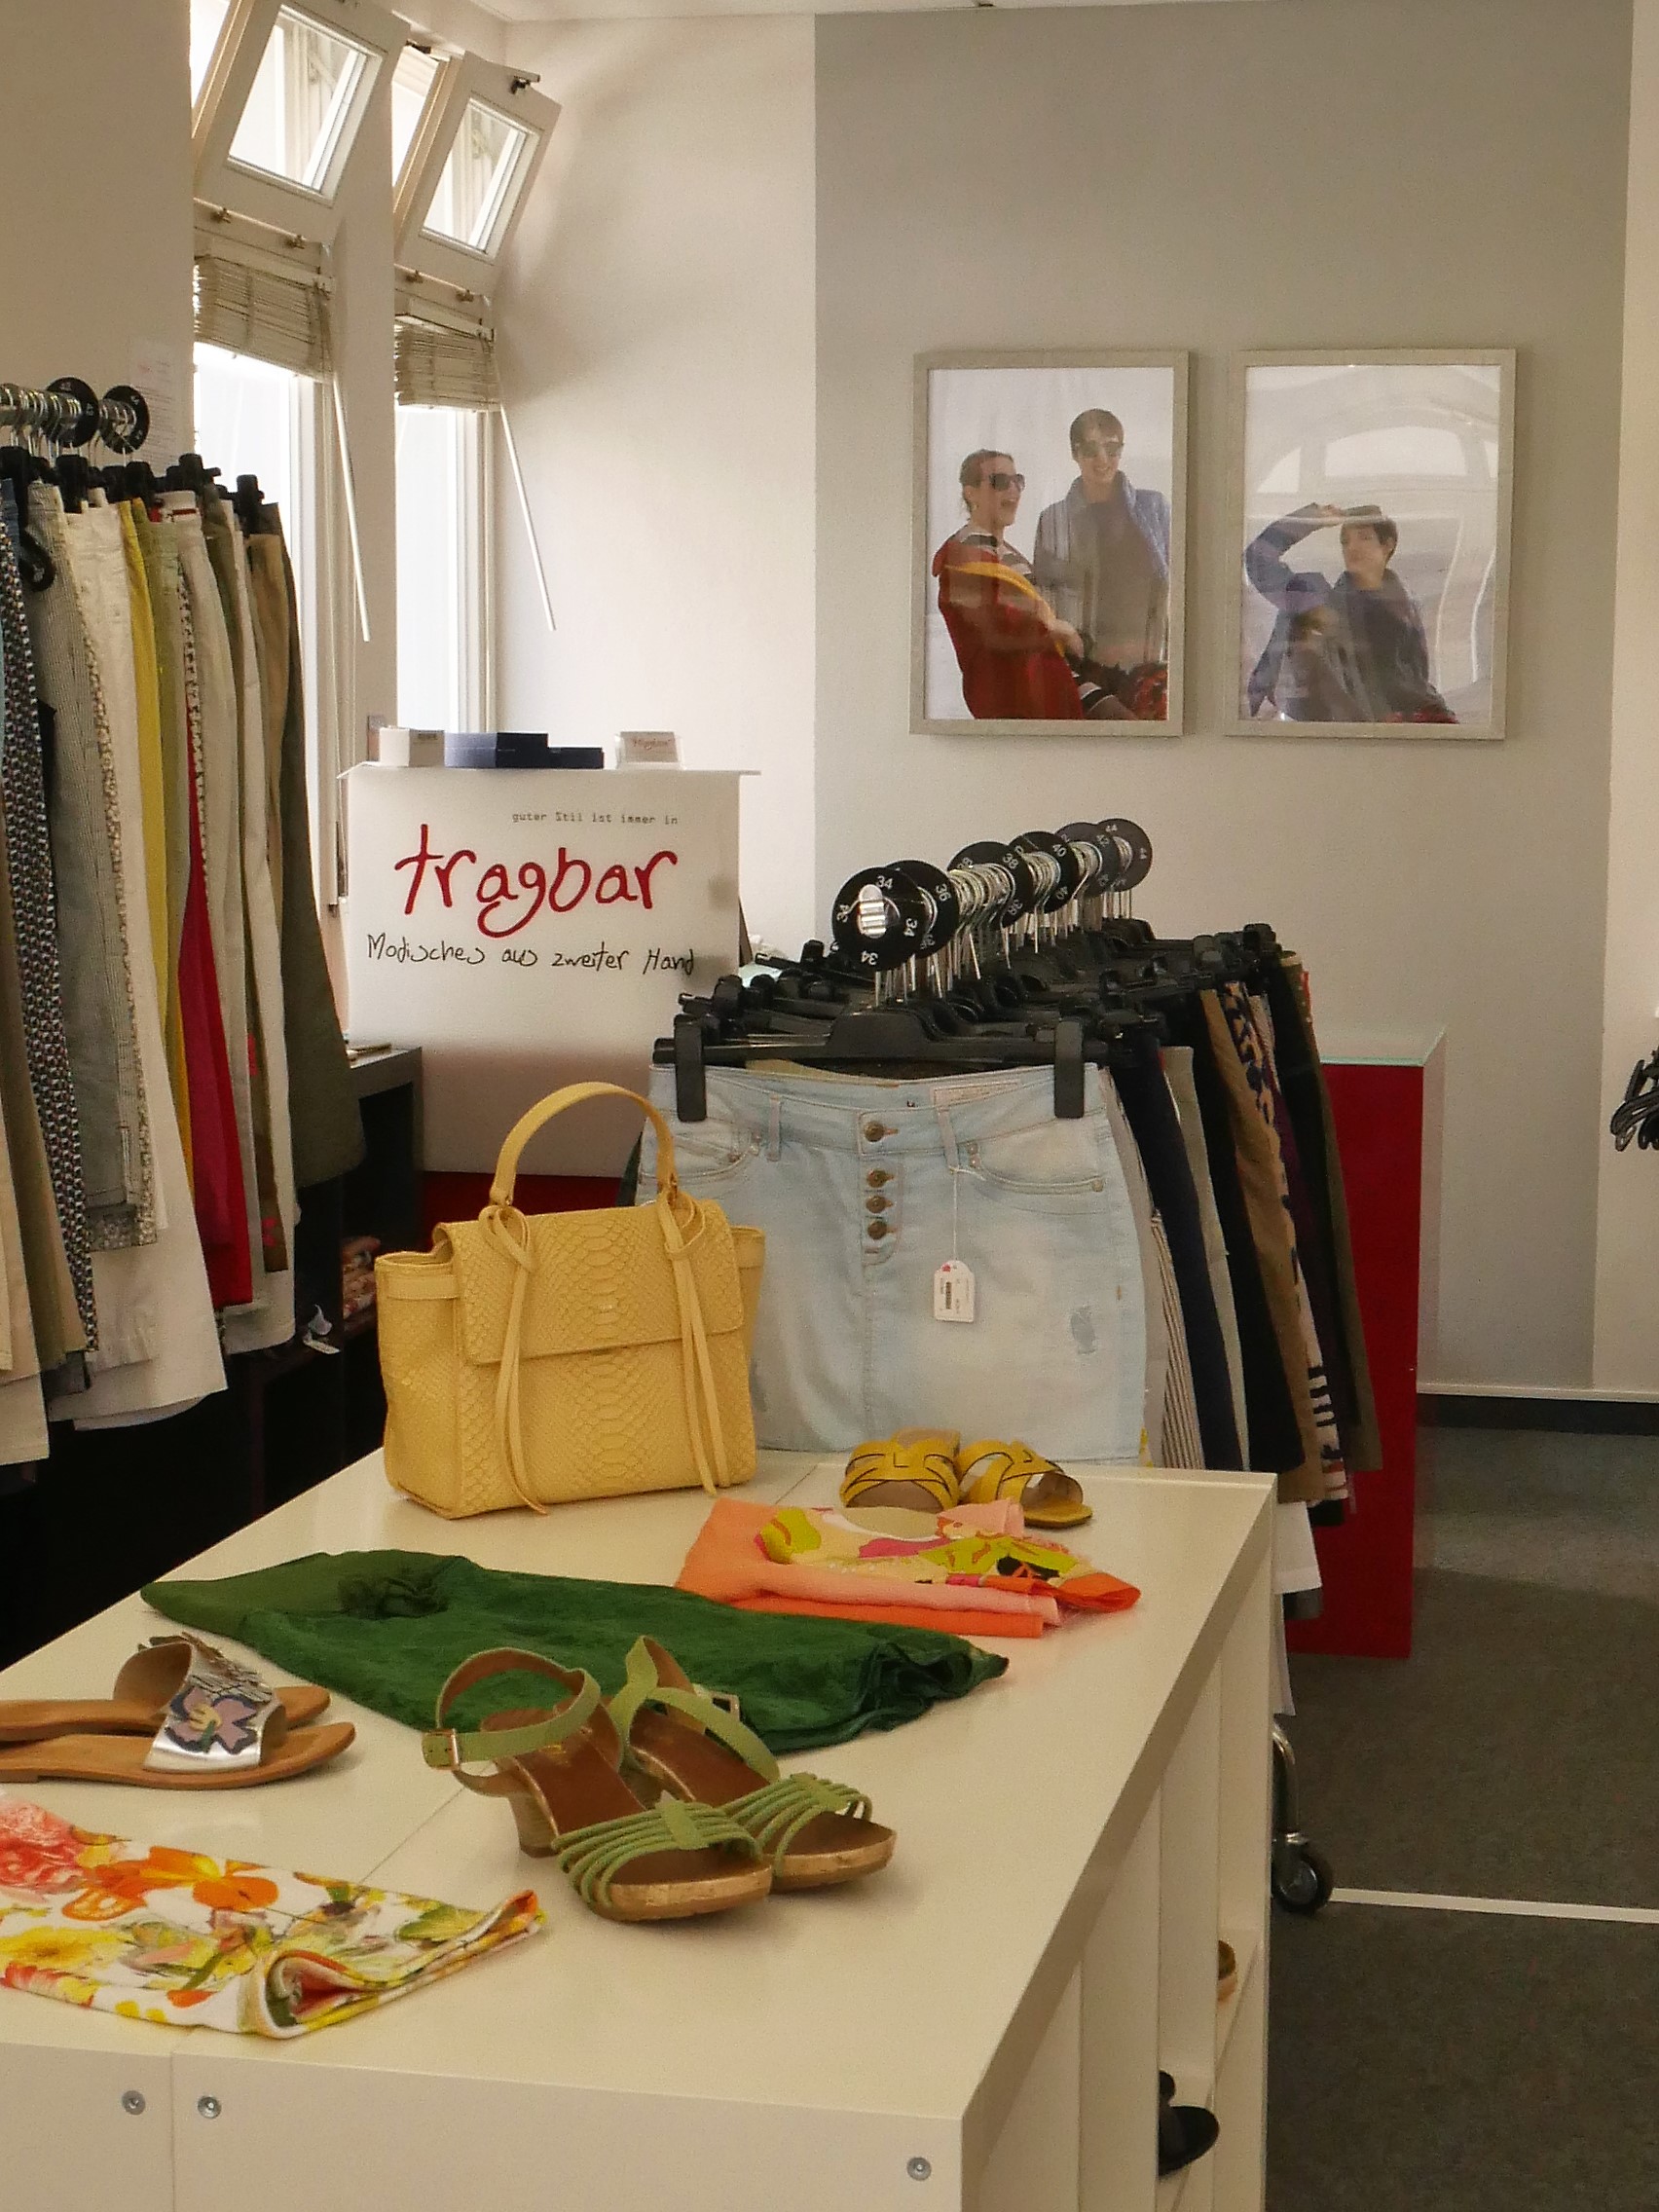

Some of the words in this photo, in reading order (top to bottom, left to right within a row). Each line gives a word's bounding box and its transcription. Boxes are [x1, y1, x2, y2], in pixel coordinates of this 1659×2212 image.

[512, 813, 547, 824] guter
[555, 811, 583, 823] Stil
[592, 812, 612, 824] ist
[621, 813, 656, 825] immer
[664, 815, 679, 826] in
[1052, 843, 1067, 858] 40
[1002, 852, 1019, 869] 38
[395, 824, 678, 939] tragbar
[876, 875, 894, 890] 34
[936, 883, 952, 902] 36
[903, 917, 918, 938] 34
[367, 932, 486, 965] Modisches
[501, 945, 538, 968] aus
[550, 940, 631, 973] zweiter
[642, 947, 694, 976] Hand
[861, 949, 879, 966] 34
